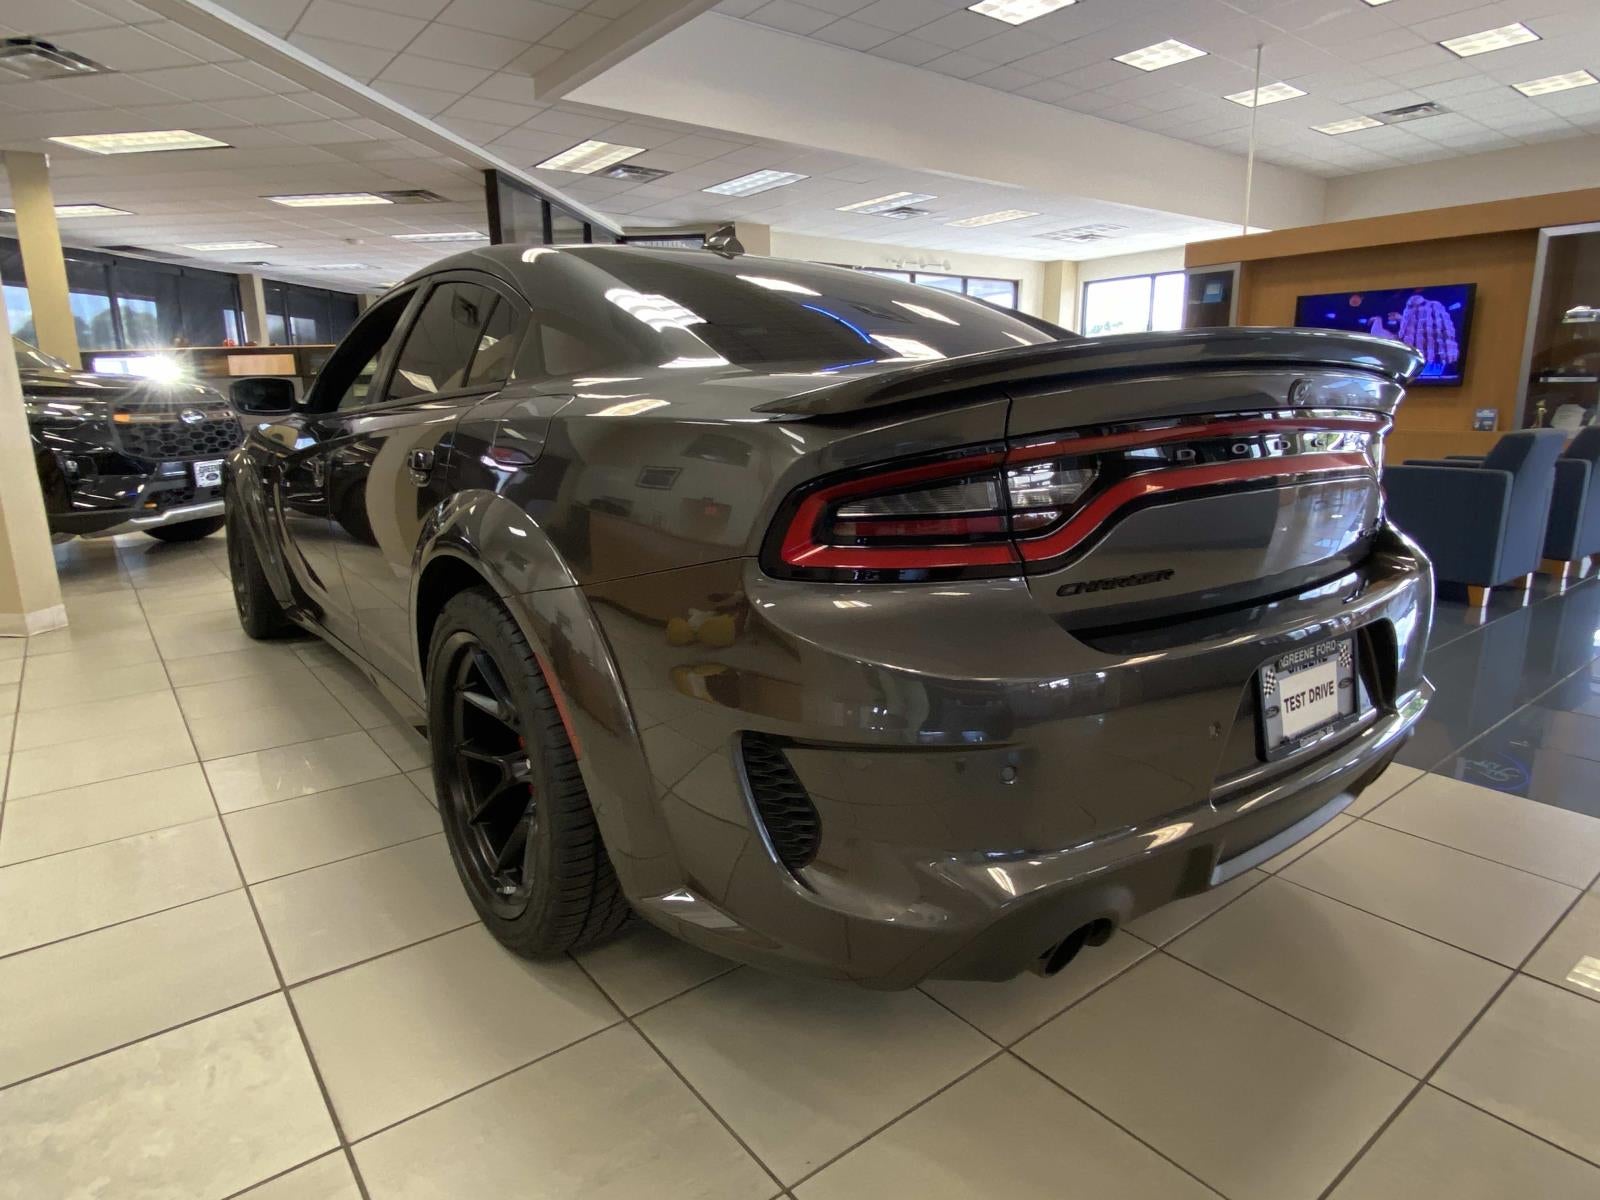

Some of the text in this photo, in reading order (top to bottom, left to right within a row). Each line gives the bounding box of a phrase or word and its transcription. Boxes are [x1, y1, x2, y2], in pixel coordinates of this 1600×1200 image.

[1176, 435, 1350, 462] DODG
[1283, 647, 1315, 667] GREENE
[1316, 640, 1336, 656] FORD
[1284, 691, 1306, 713] TEST
[1308, 680, 1334, 703] DRIVE
